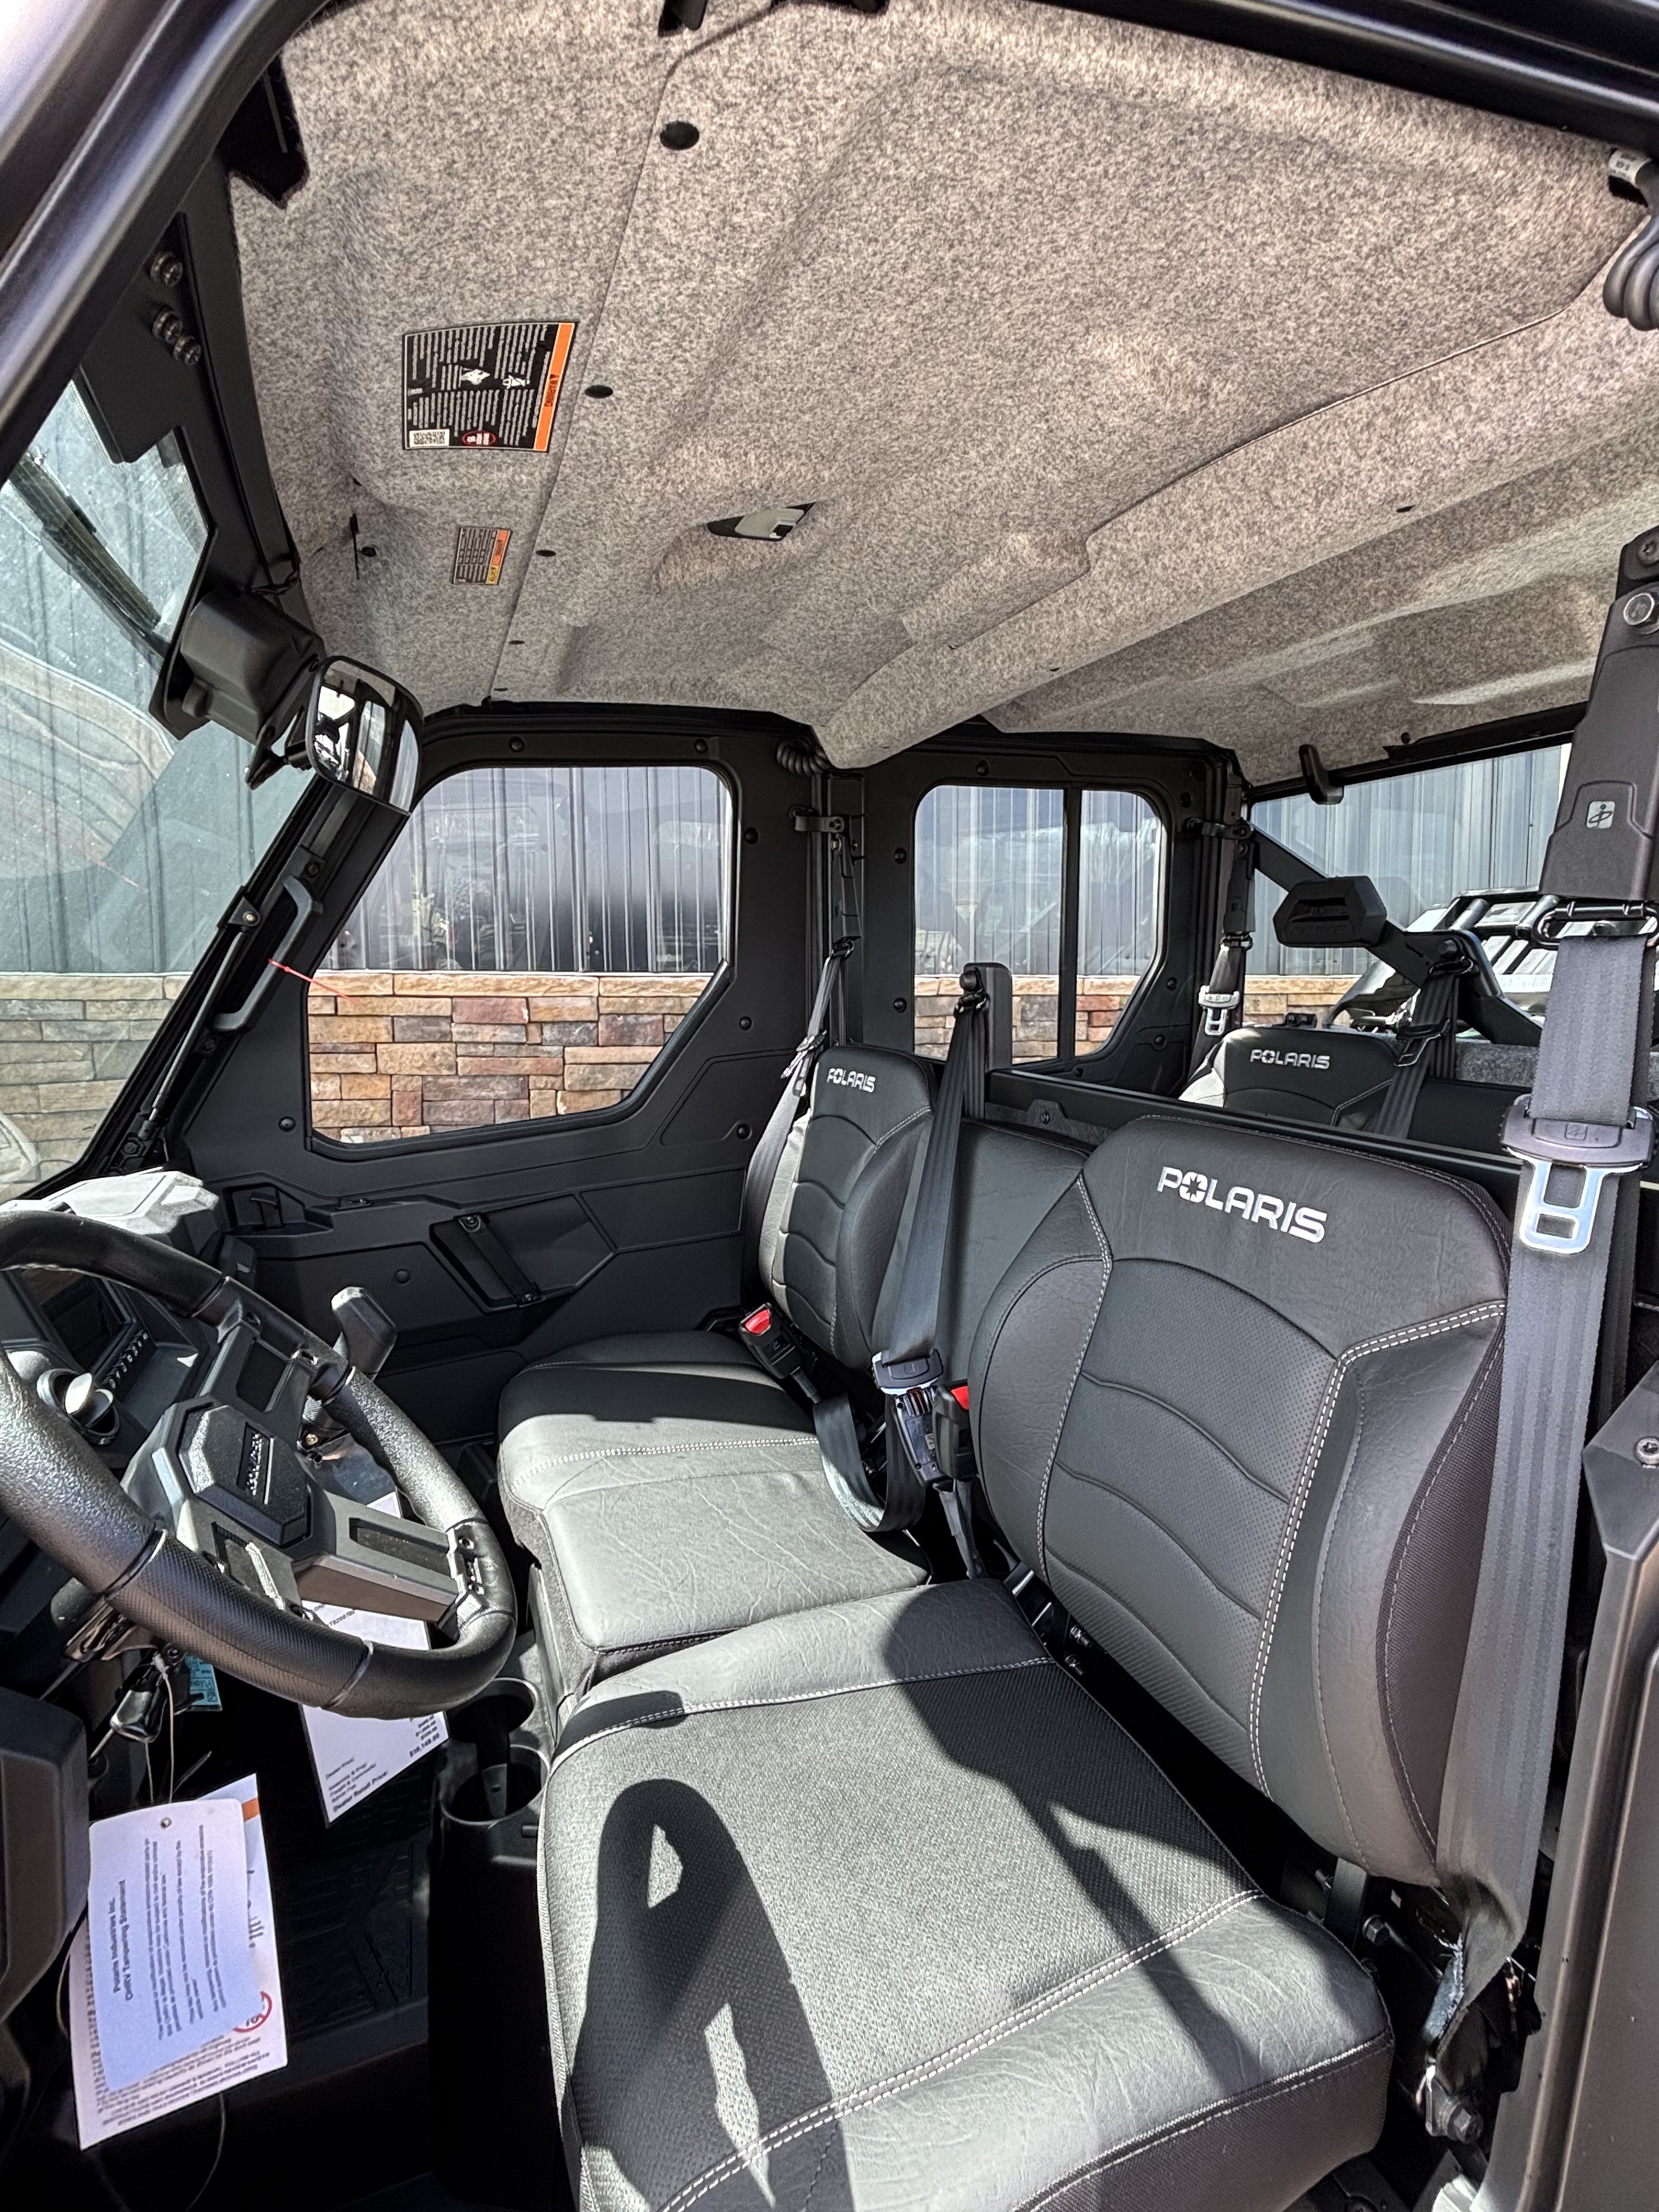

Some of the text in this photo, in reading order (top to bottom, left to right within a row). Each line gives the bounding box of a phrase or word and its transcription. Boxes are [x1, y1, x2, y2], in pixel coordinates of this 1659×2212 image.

[1249, 1049, 1331, 1070] POLARIS
[826, 1068, 876, 1093] POLARIS
[1156, 1166, 1328, 1243] POLARIS
